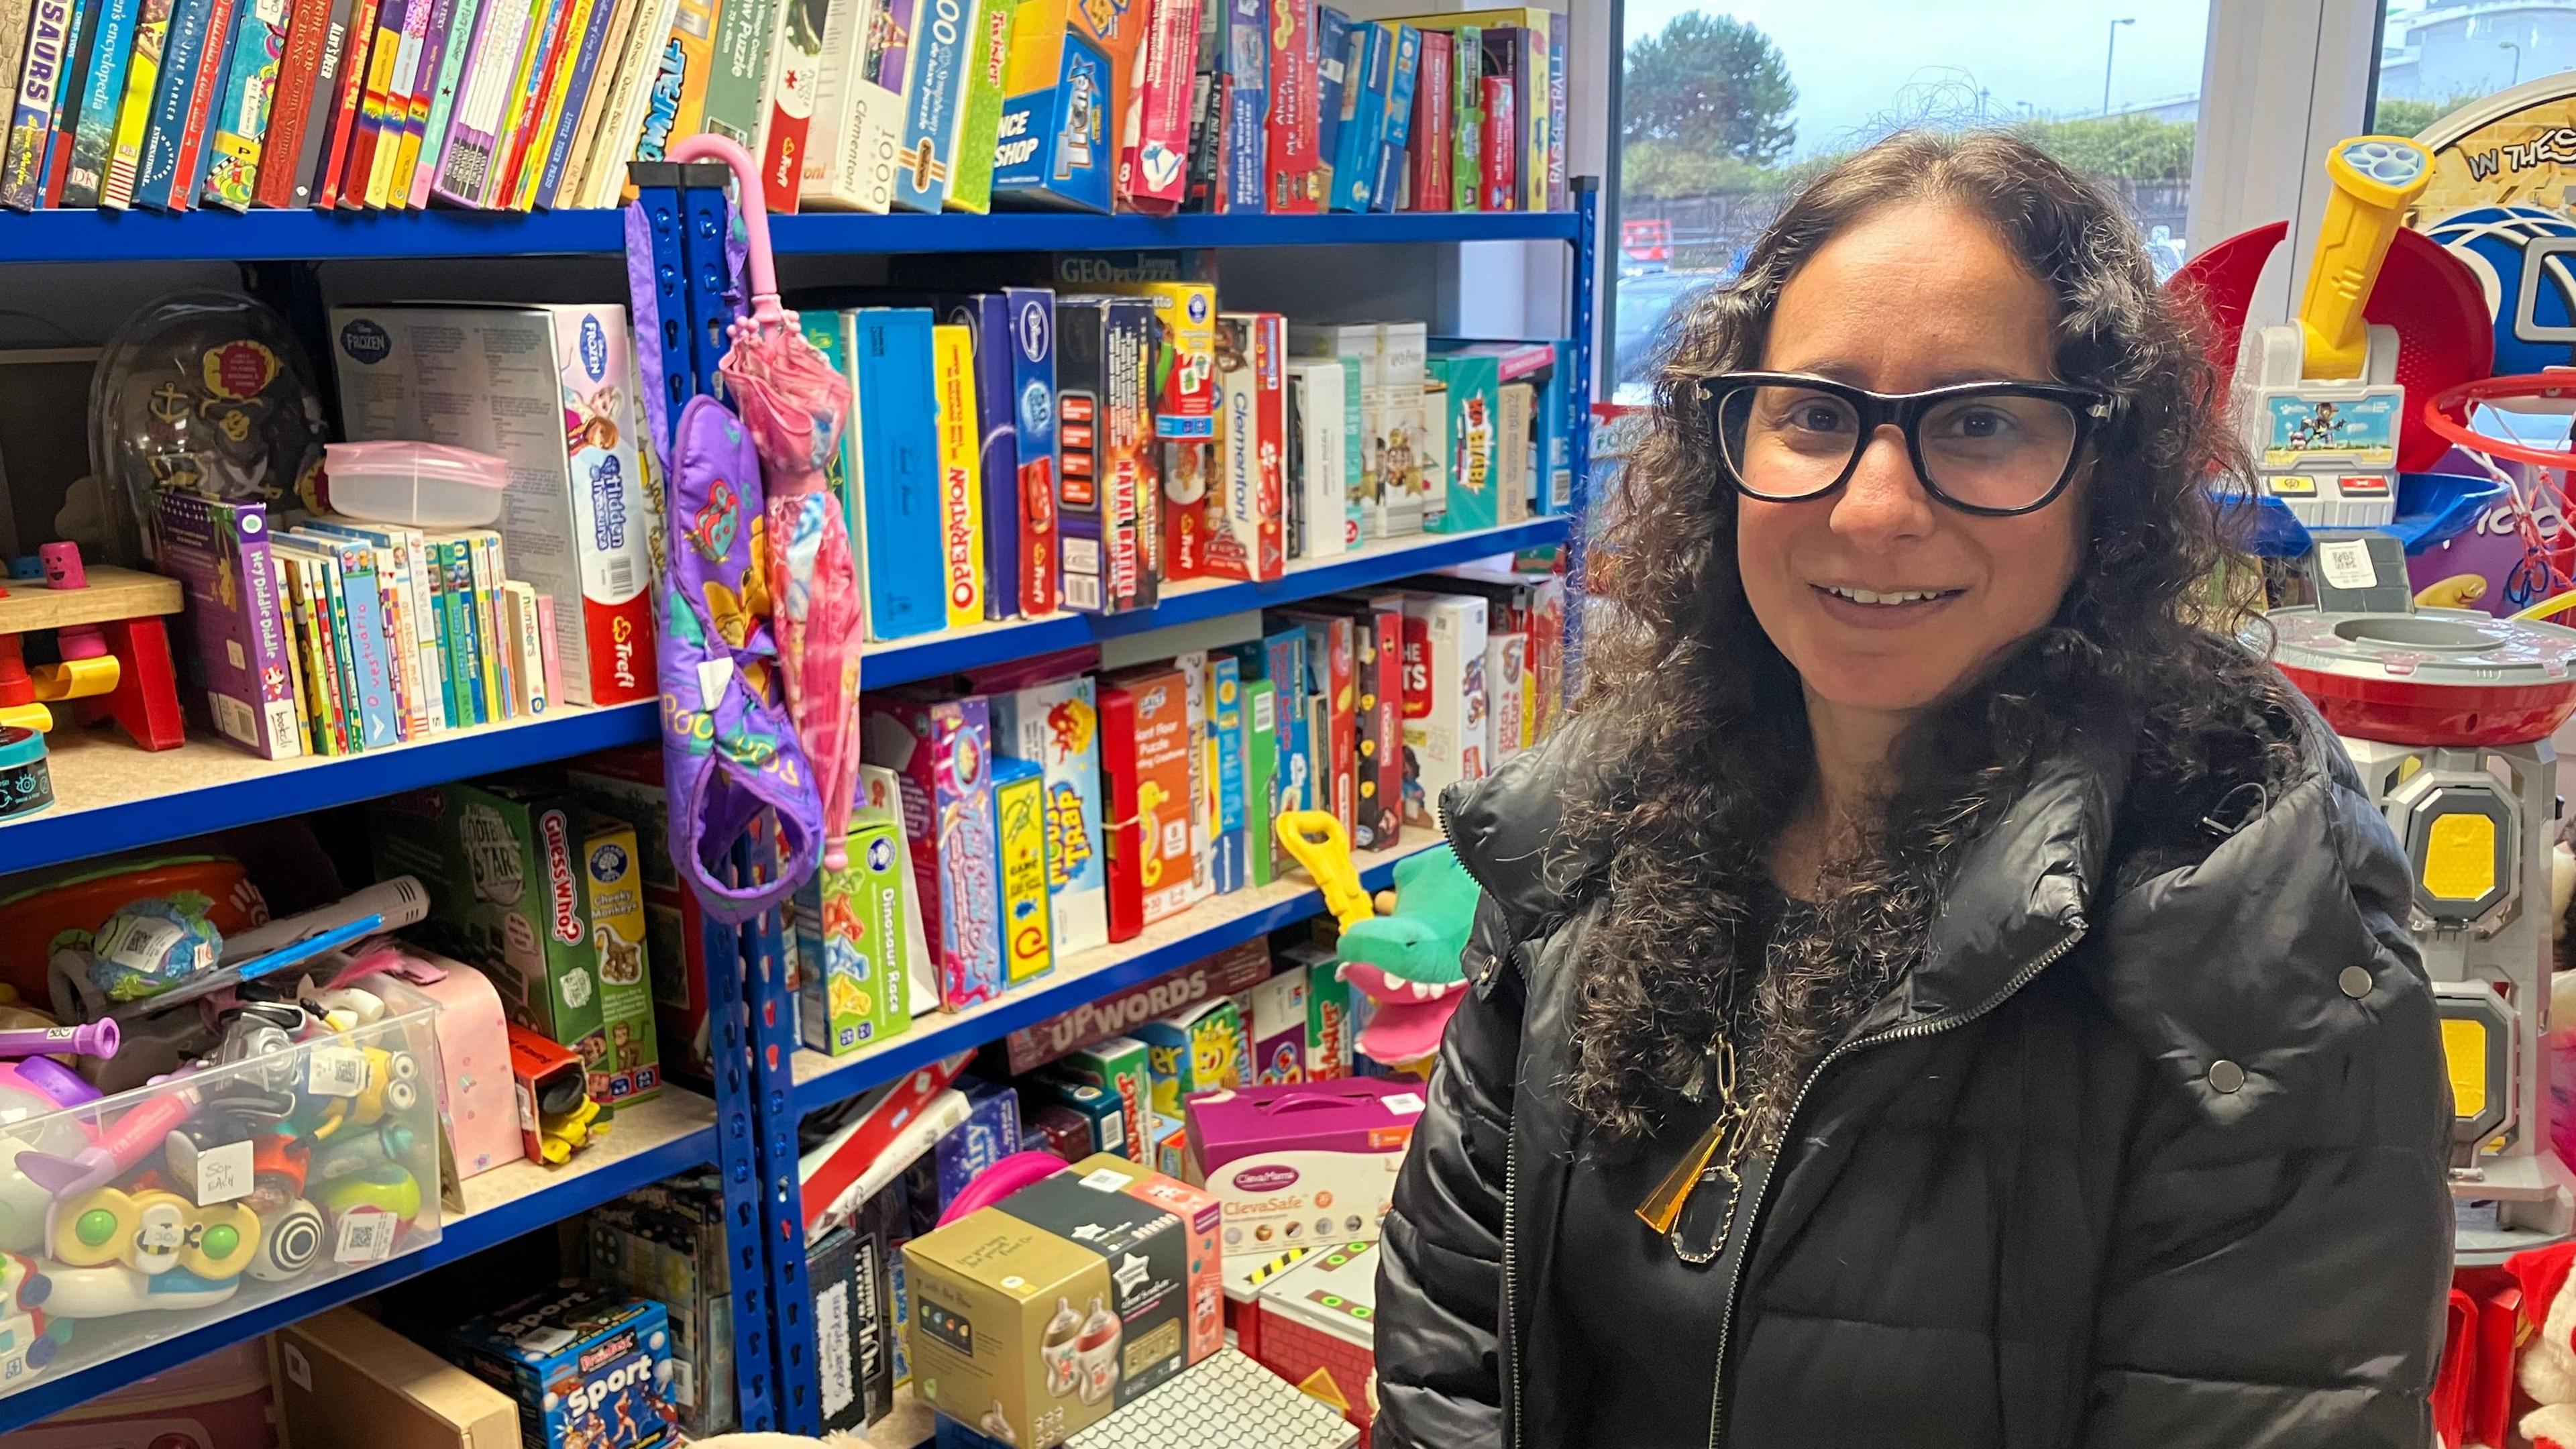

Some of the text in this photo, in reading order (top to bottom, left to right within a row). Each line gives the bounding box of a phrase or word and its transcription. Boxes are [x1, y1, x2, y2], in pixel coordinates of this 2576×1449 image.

[25, 0, 65, 103] SAURS
[731, 21, 753, 77] Puzzle
[932, 0, 960, 44] 00
[989, 11, 1005, 89] Twister
[92, 23, 119, 110] encyclopedia
[176, 42, 191, 70] JANE
[321, 52, 338, 79] DEER
[344, 4, 376, 109] The Junior Novel
[166, 77, 184, 121] PARKER
[639, 40, 686, 162] OWNFALL
[1236, 99, 1244, 148] Worlds
[1285, 51, 1297, 156] Me Hearties!
[142, 126, 160, 187] INTERNATIONAL
[804, 164, 826, 180] oni
[845, 99, 867, 194] Clementoni
[873, 129, 896, 204] 1000
[994, 138, 1039, 168] SHOP
[2469, 148, 2499, 182] IN
[72, 168, 99, 189] DK
[347, 333, 385, 350] FROZEN
[585, 323, 602, 374] FROZEN
[1028, 310, 1042, 360] Disney
[1232, 390, 1248, 523] Clementoni
[604, 474, 625, 548] Hidden
[1118, 458, 1136, 523] NAVAL
[949, 468, 974, 609] OPERATION
[1117, 523, 1137, 598] BATTLE
[249, 551, 280, 659] Hey Diddle Diddle
[402, 600, 411, 616] all
[522, 596, 537, 658] numbers
[354, 603, 380, 708] O vestuário
[404, 621, 417, 659] about
[614, 639, 634, 688] Trefl
[1155, 720, 1179, 737] Floor
[1058, 791, 1093, 868] TRAP
[593, 900, 638, 919] Monkeys
[594, 889, 633, 906] Cheeky
[882, 887, 900, 1014] Dinosaur Race
[1051, 970, 1208, 1051] UPWORDS
[1223, 1195, 1303, 1216] ClevaSafe
[567, 1354, 653, 1419] Sport
